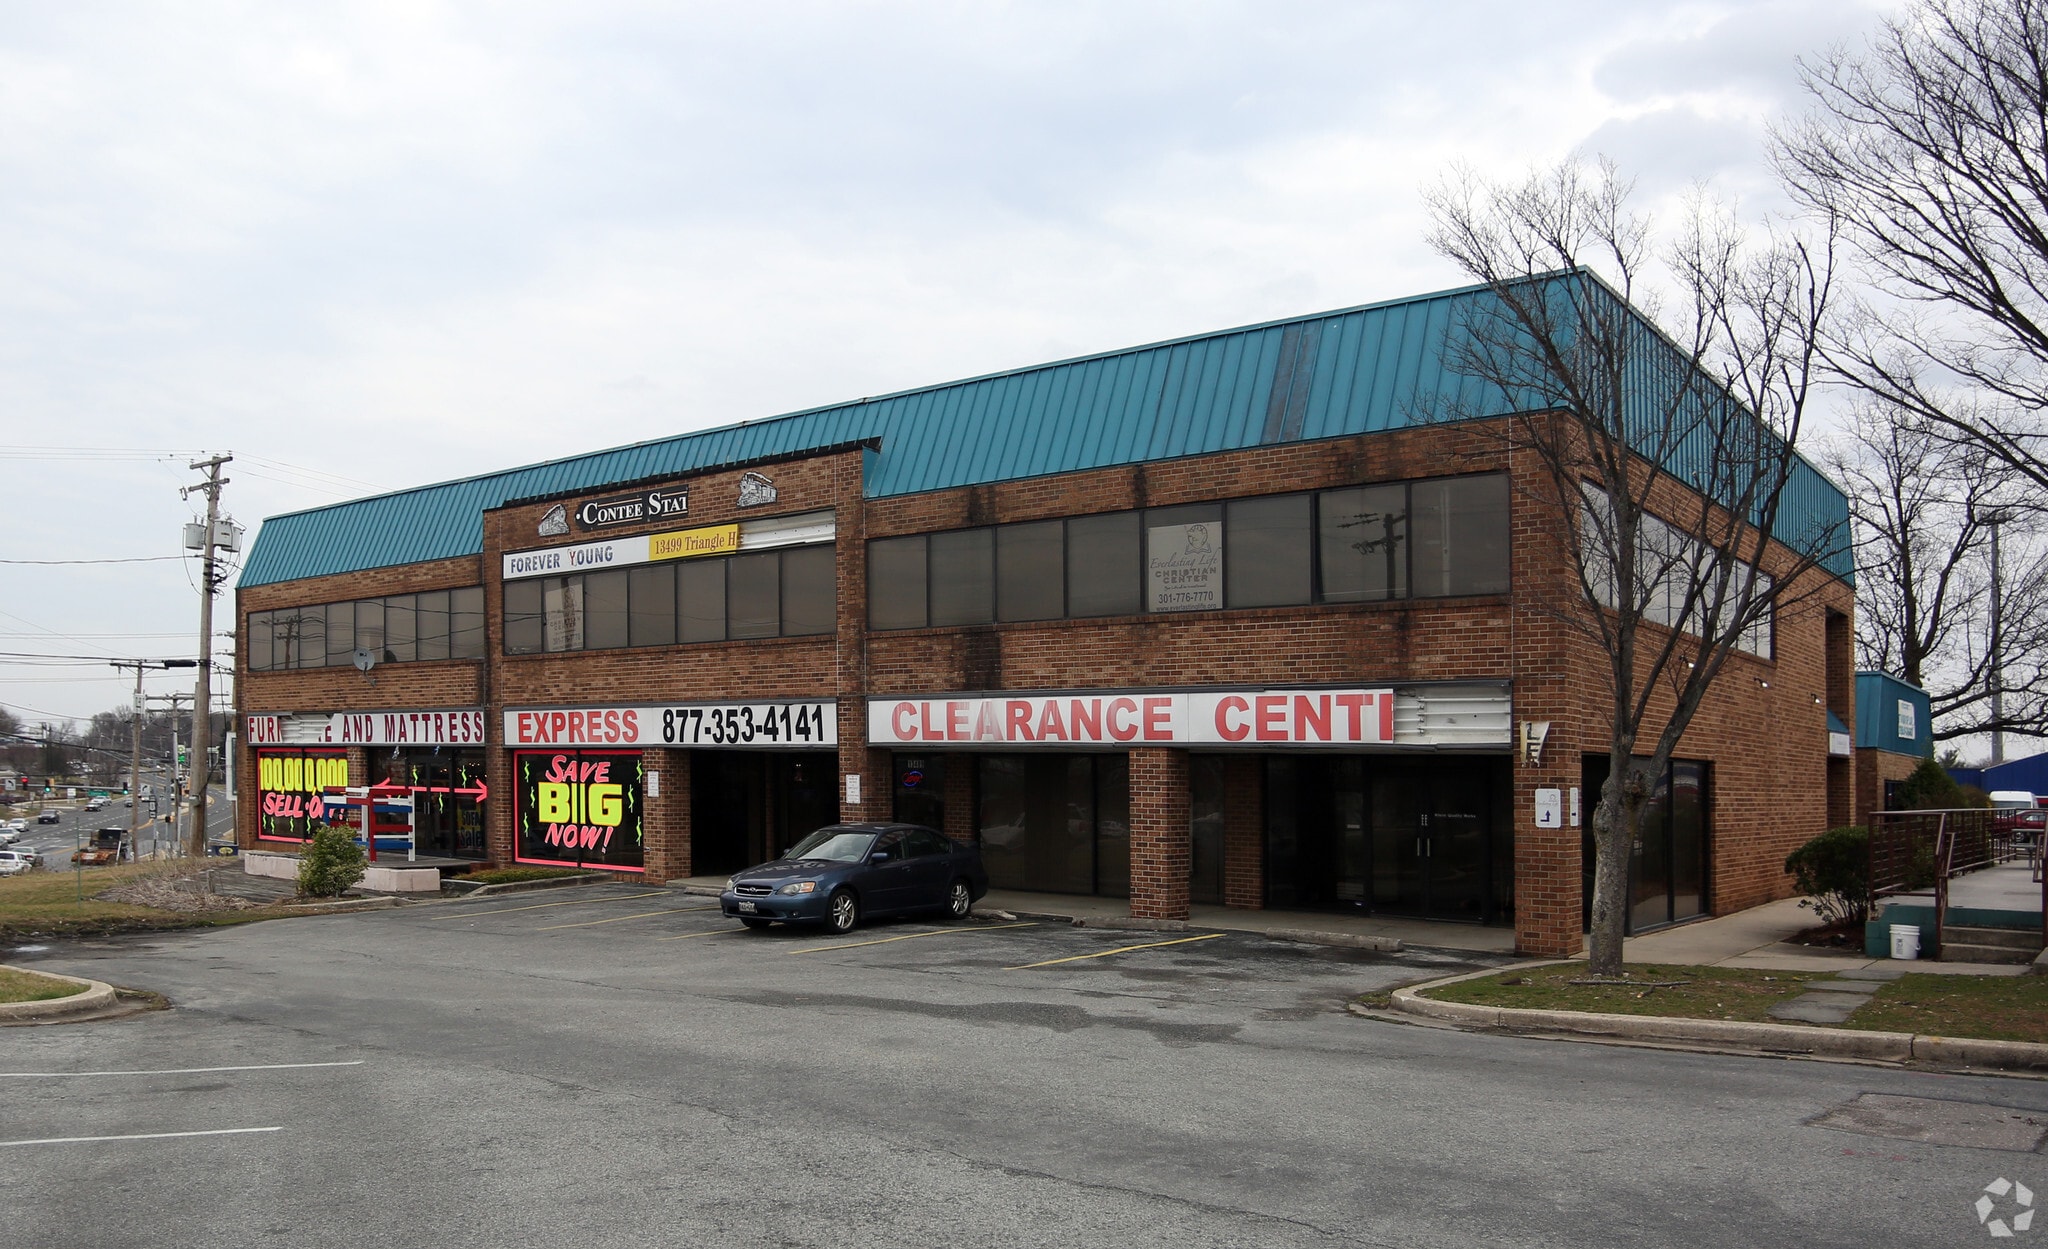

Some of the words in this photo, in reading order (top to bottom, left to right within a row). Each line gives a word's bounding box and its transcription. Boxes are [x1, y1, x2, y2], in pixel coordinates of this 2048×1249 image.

[583, 502, 643, 524] CONTEE
[655, 537, 682, 555] 13499
[684, 533, 724, 551] Triangle
[510, 553, 560, 574] FOREVER
[569, 545, 614, 566] YOUNG
[1150, 552, 1195, 569] Everlasting
[1155, 567, 1217, 578] CHRISTIAN
[1163, 575, 1208, 584] CENTER
[1158, 591, 1214, 604] 301-776-7770
[342, 714, 373, 743] AND
[384, 711, 484, 743] MATTRESS
[517, 710, 639, 743] EXPRESS
[662, 704, 824, 744] 877-353-4141
[891, 697, 1173, 742] CLEARANCE
[545, 754, 611, 783] SAVE
[538, 781, 623, 827] BIG
[544, 822, 614, 854] NOW!
